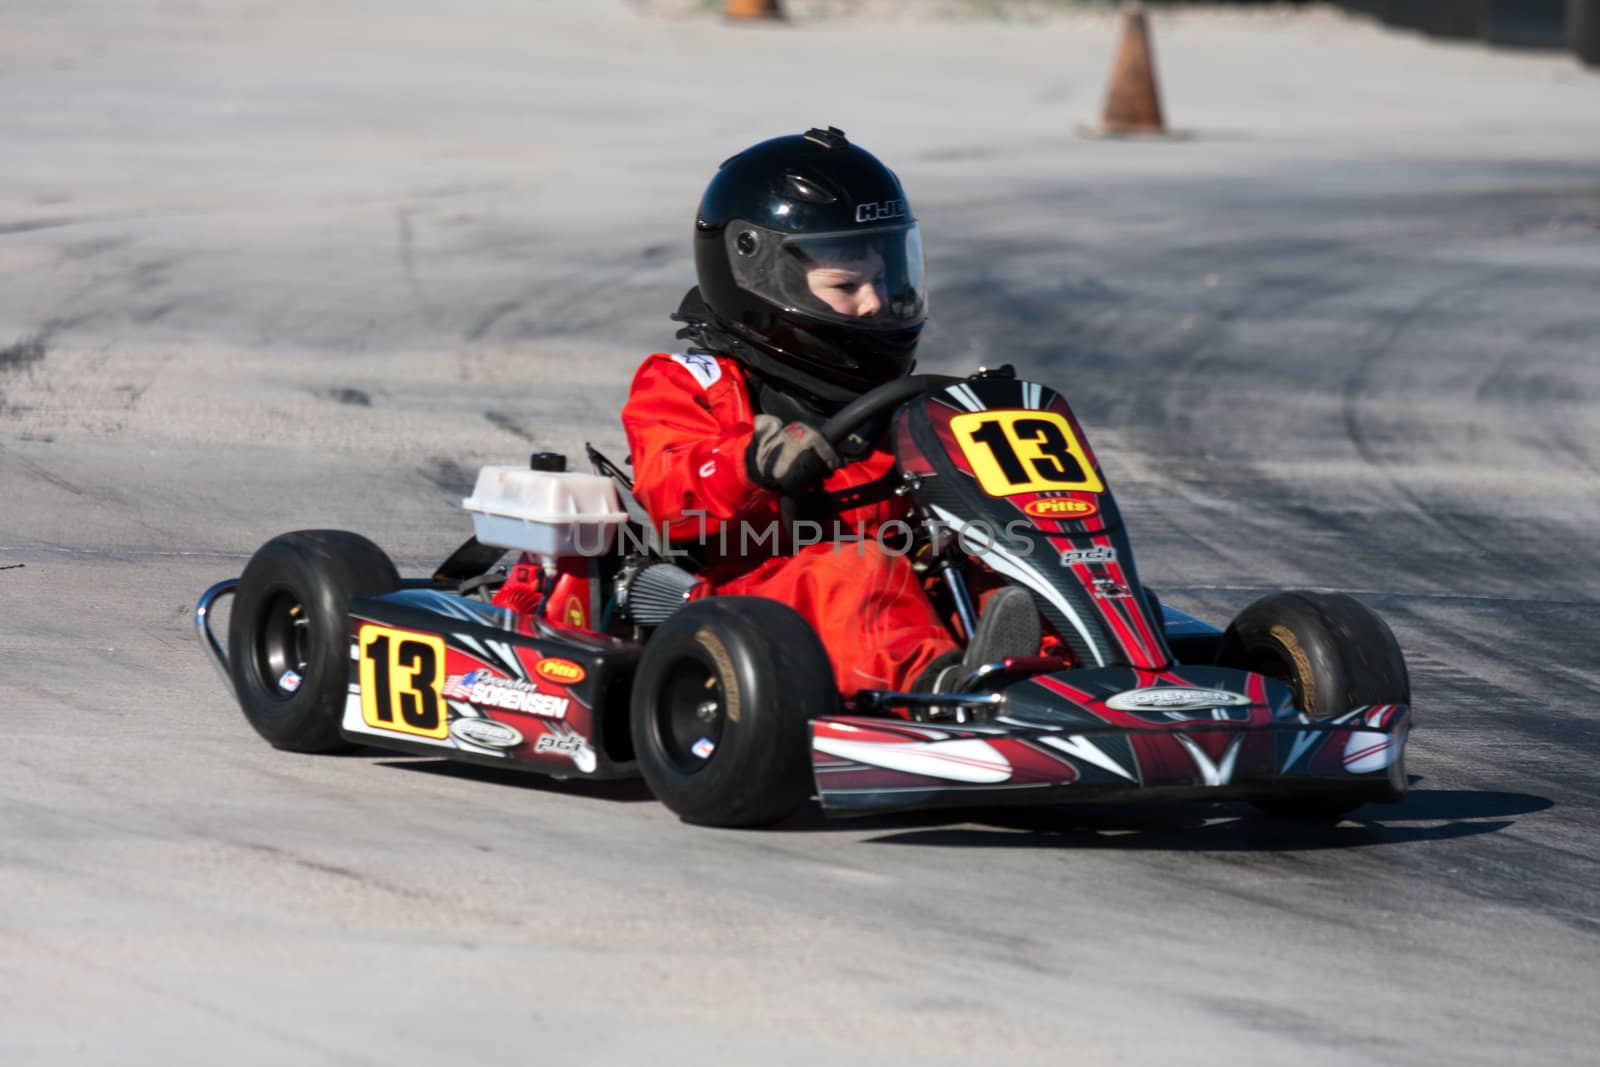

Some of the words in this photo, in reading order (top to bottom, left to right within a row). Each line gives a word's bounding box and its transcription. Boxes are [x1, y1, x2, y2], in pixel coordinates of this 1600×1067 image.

[970, 419, 1088, 486] 13
[366, 635, 440, 730] 13
[470, 683, 569, 719] SORENSEN
